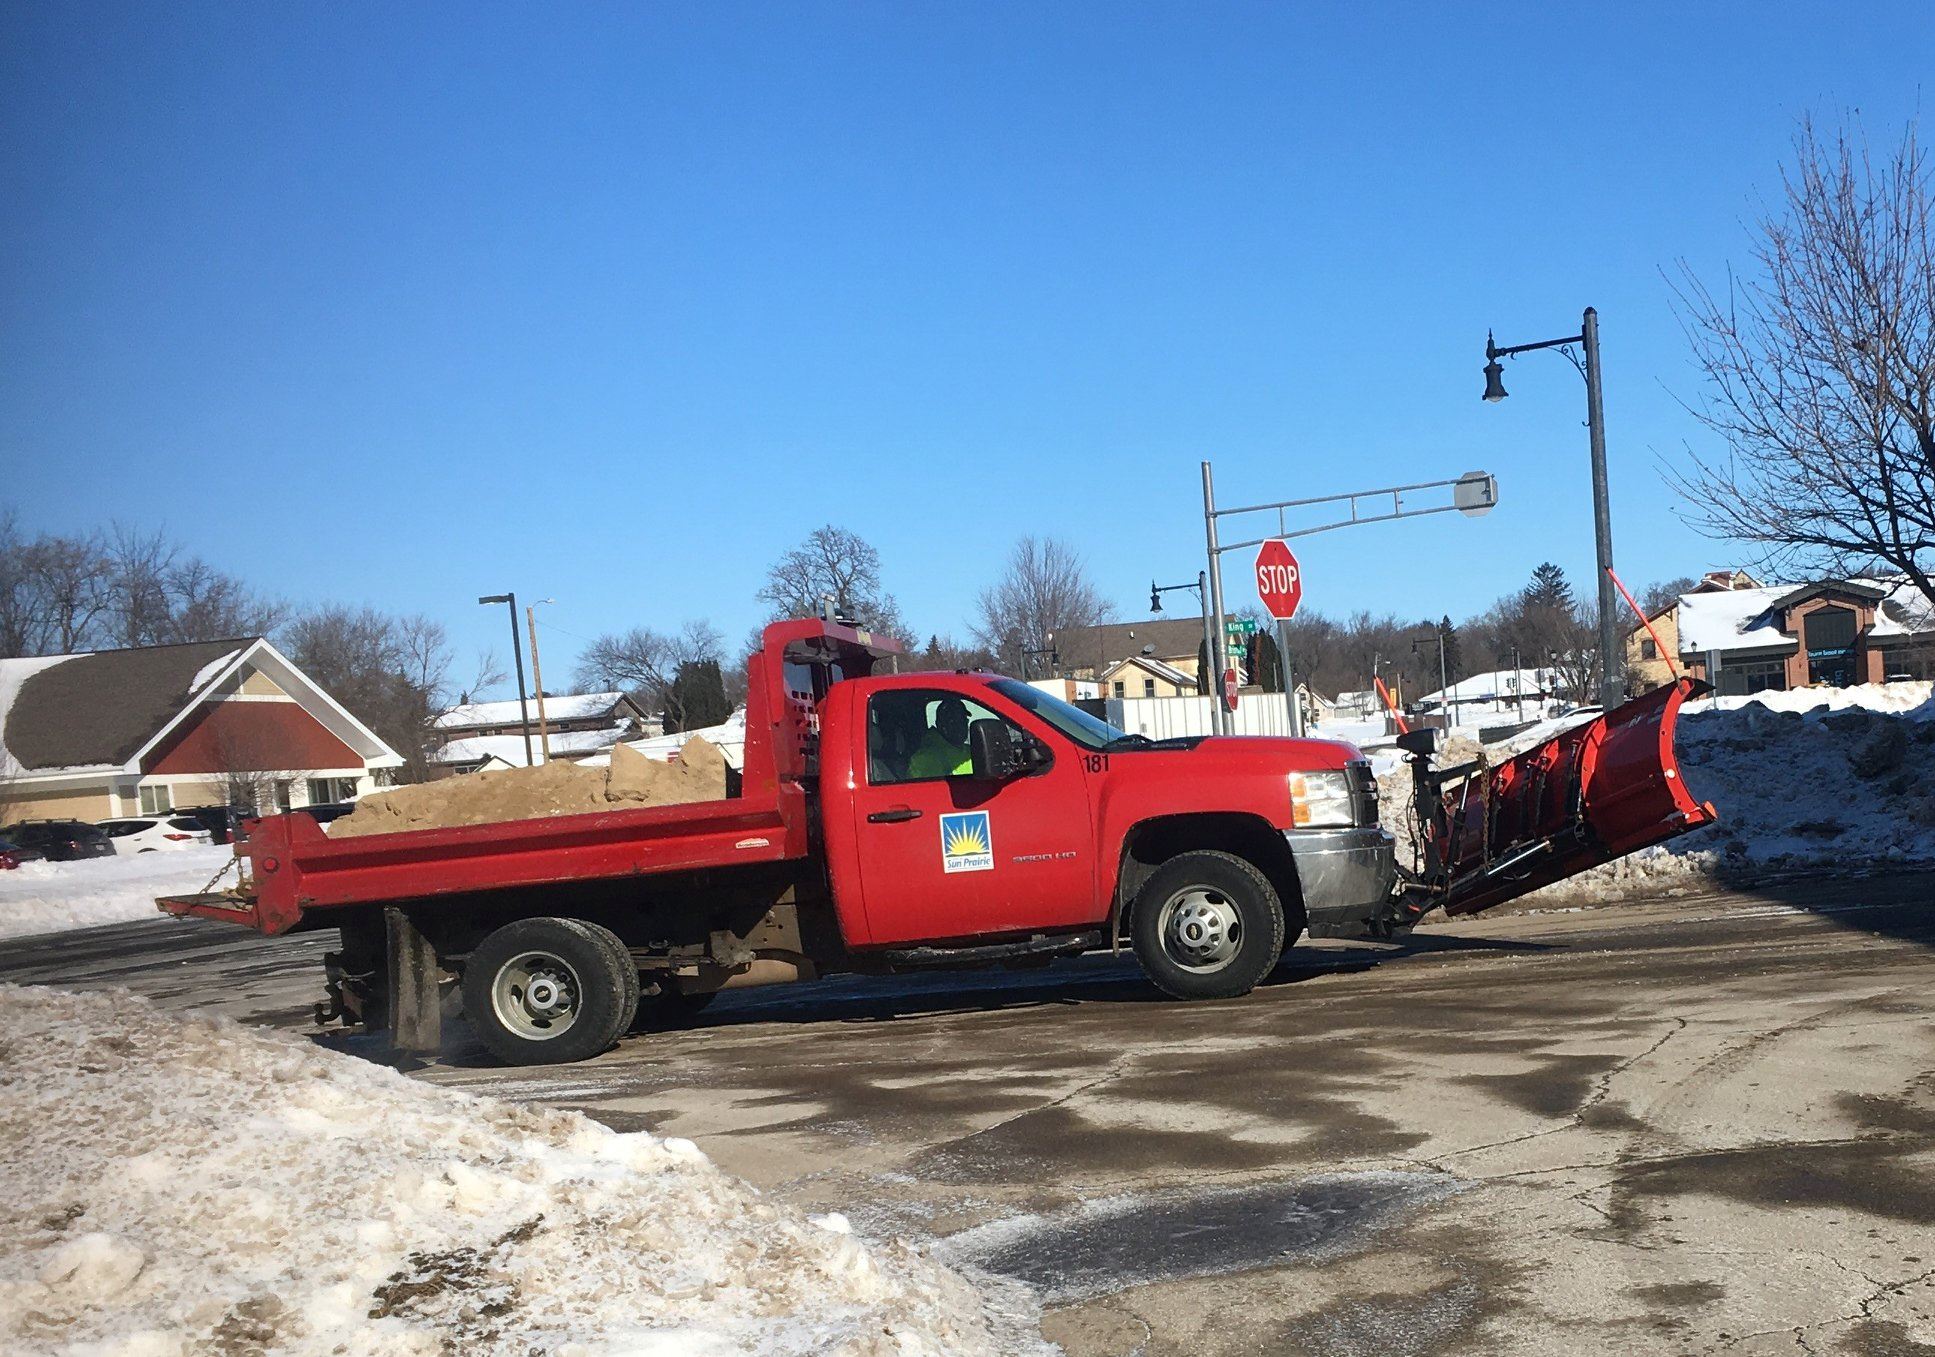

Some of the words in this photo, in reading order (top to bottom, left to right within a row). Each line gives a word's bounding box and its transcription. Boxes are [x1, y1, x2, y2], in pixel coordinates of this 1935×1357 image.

[1259, 565, 1298, 594] STOP
[1228, 622, 1244, 632] King
[1226, 681, 1238, 697] STOP
[1082, 754, 1109, 773] 181
[947, 858, 962, 869] Sun
[963, 857, 991, 868] Prairie
